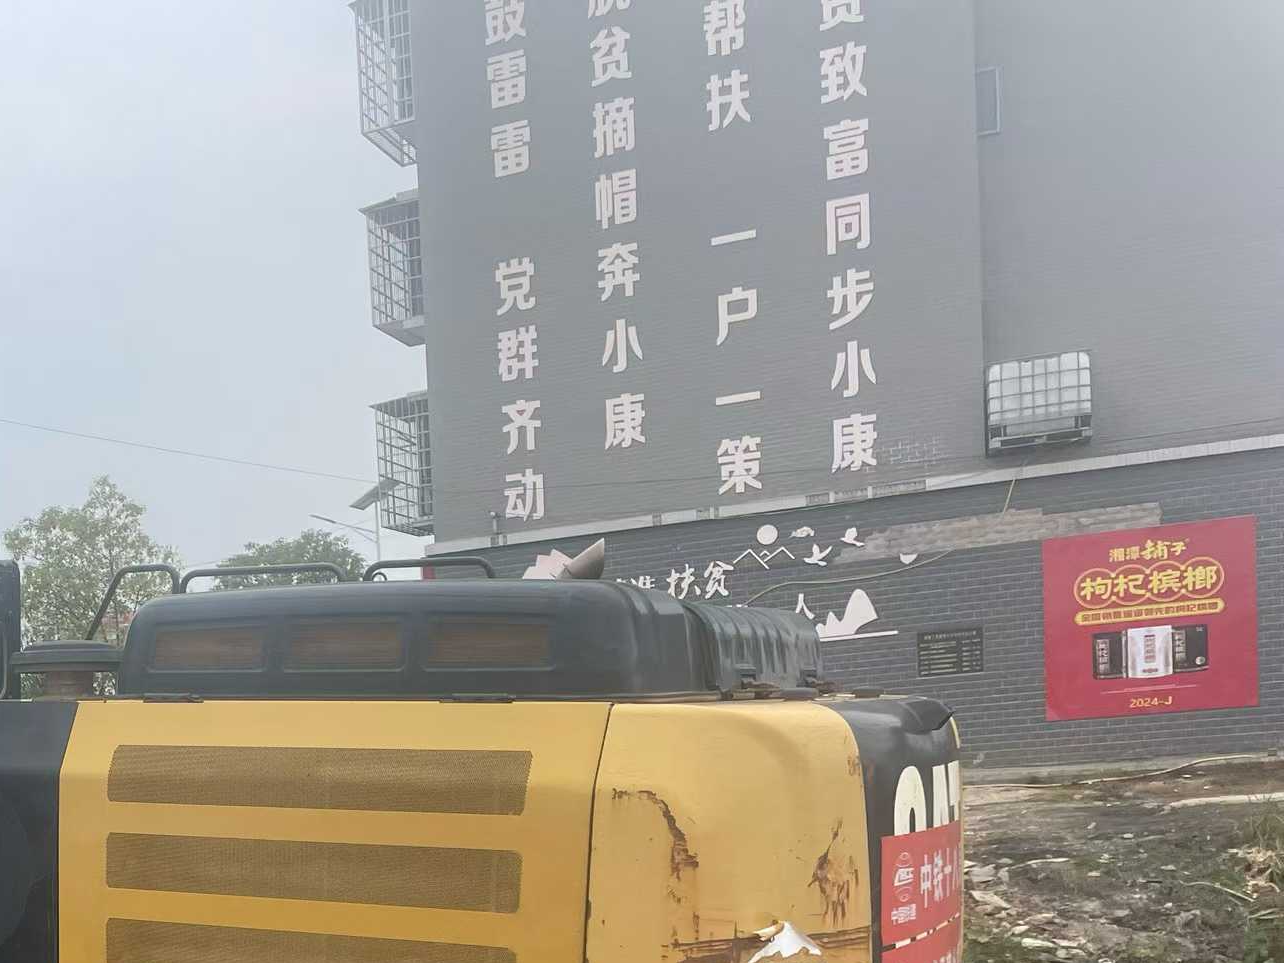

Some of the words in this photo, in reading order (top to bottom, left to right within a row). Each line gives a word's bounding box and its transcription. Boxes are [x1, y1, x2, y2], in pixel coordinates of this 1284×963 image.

[703, 0, 752, 132] 帮扶
[495, 257, 545, 522] 党群齐动
[710, 229, 763, 496] 一户一策
[1080, 566, 1218, 600] 枸杞槟榔
[1129, 696, 1173, 708] 2024-J
